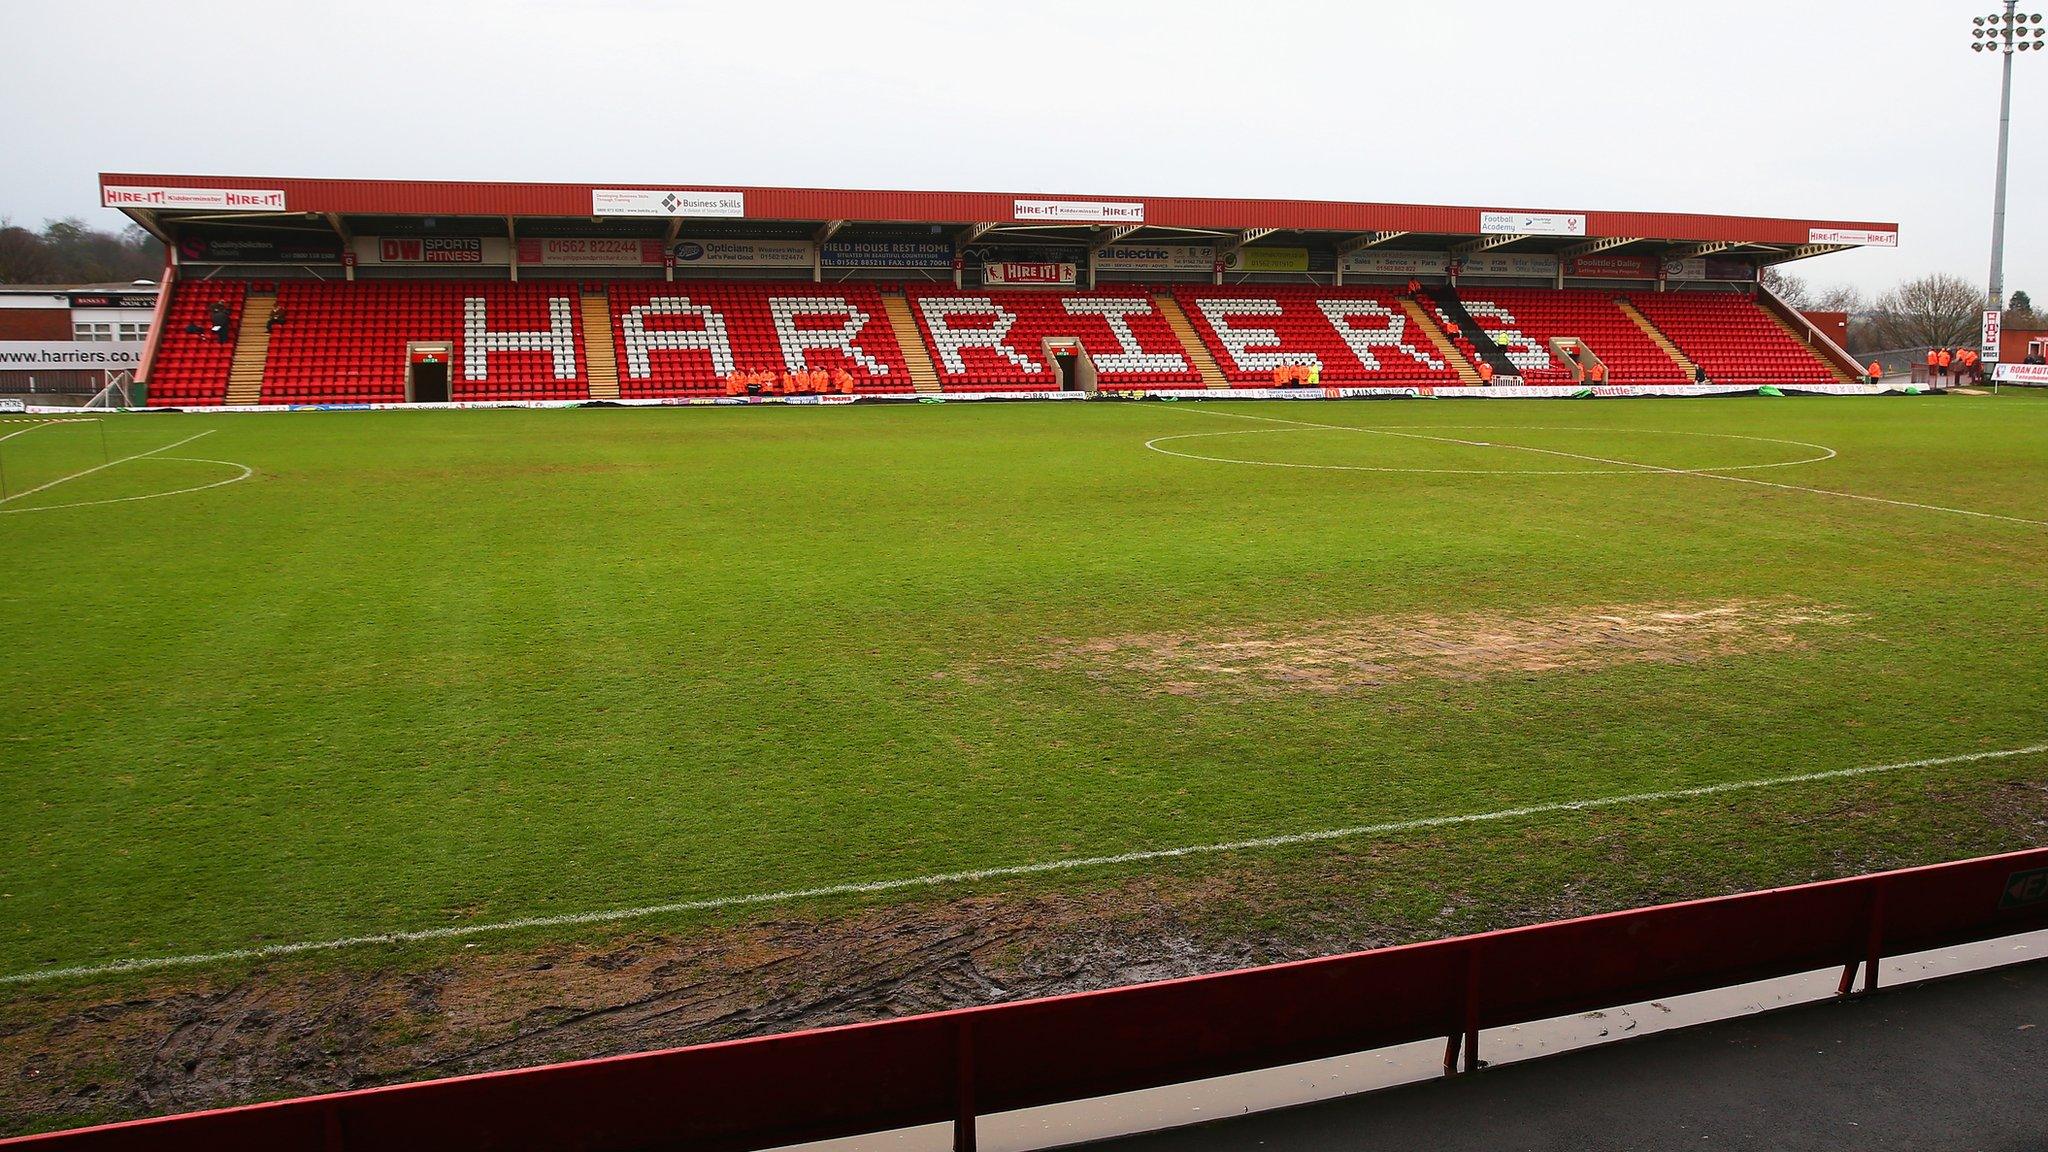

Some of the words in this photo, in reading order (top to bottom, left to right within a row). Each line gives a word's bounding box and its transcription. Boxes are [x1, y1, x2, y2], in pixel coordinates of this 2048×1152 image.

[106, 189, 166, 205] HIRE-IT!
[167, 194, 222, 203] Kidderminster
[225, 192, 282, 207] HIRE-IT!
[683, 199, 717, 208] Business
[719, 199, 742, 208] Skills
[1015, 204, 1058, 215] HIRE-IT!
[1102, 206, 1144, 217] HIRE-IT!
[1485, 215, 1513, 223] Football
[1482, 223, 1515, 232] Academy
[1810, 232, 1839, 242] HIRE-IT!
[1867, 233, 1895, 243] HIRE-IT!
[381, 239, 423, 260] DW
[425, 239, 480, 250] SPORTS
[549, 240, 586, 253] 01562
[590, 240, 637, 253] 822244
[706, 243, 754, 253] Opticians
[824, 243, 851, 252] FIELD
[855, 243, 889, 252] HOUSE
[893, 243, 915, 252] REST
[919, 244, 949, 253] HOME
[426, 251, 480, 261] FITNESS
[665, 259, 673, 267] H
[1577, 259, 1611, 267] Doolittle
[1008, 264, 1037, 278] HIRE
[1040, 264, 1056, 280] IT!
[464, 297, 1550, 380] HARRIERS
[0, 349, 142, 362] www.harriers.co.u
[2032, 367, 2048, 375] AUT
[1342, 389, 1348, 397] 3
[1591, 386, 1630, 395] Shuttle
